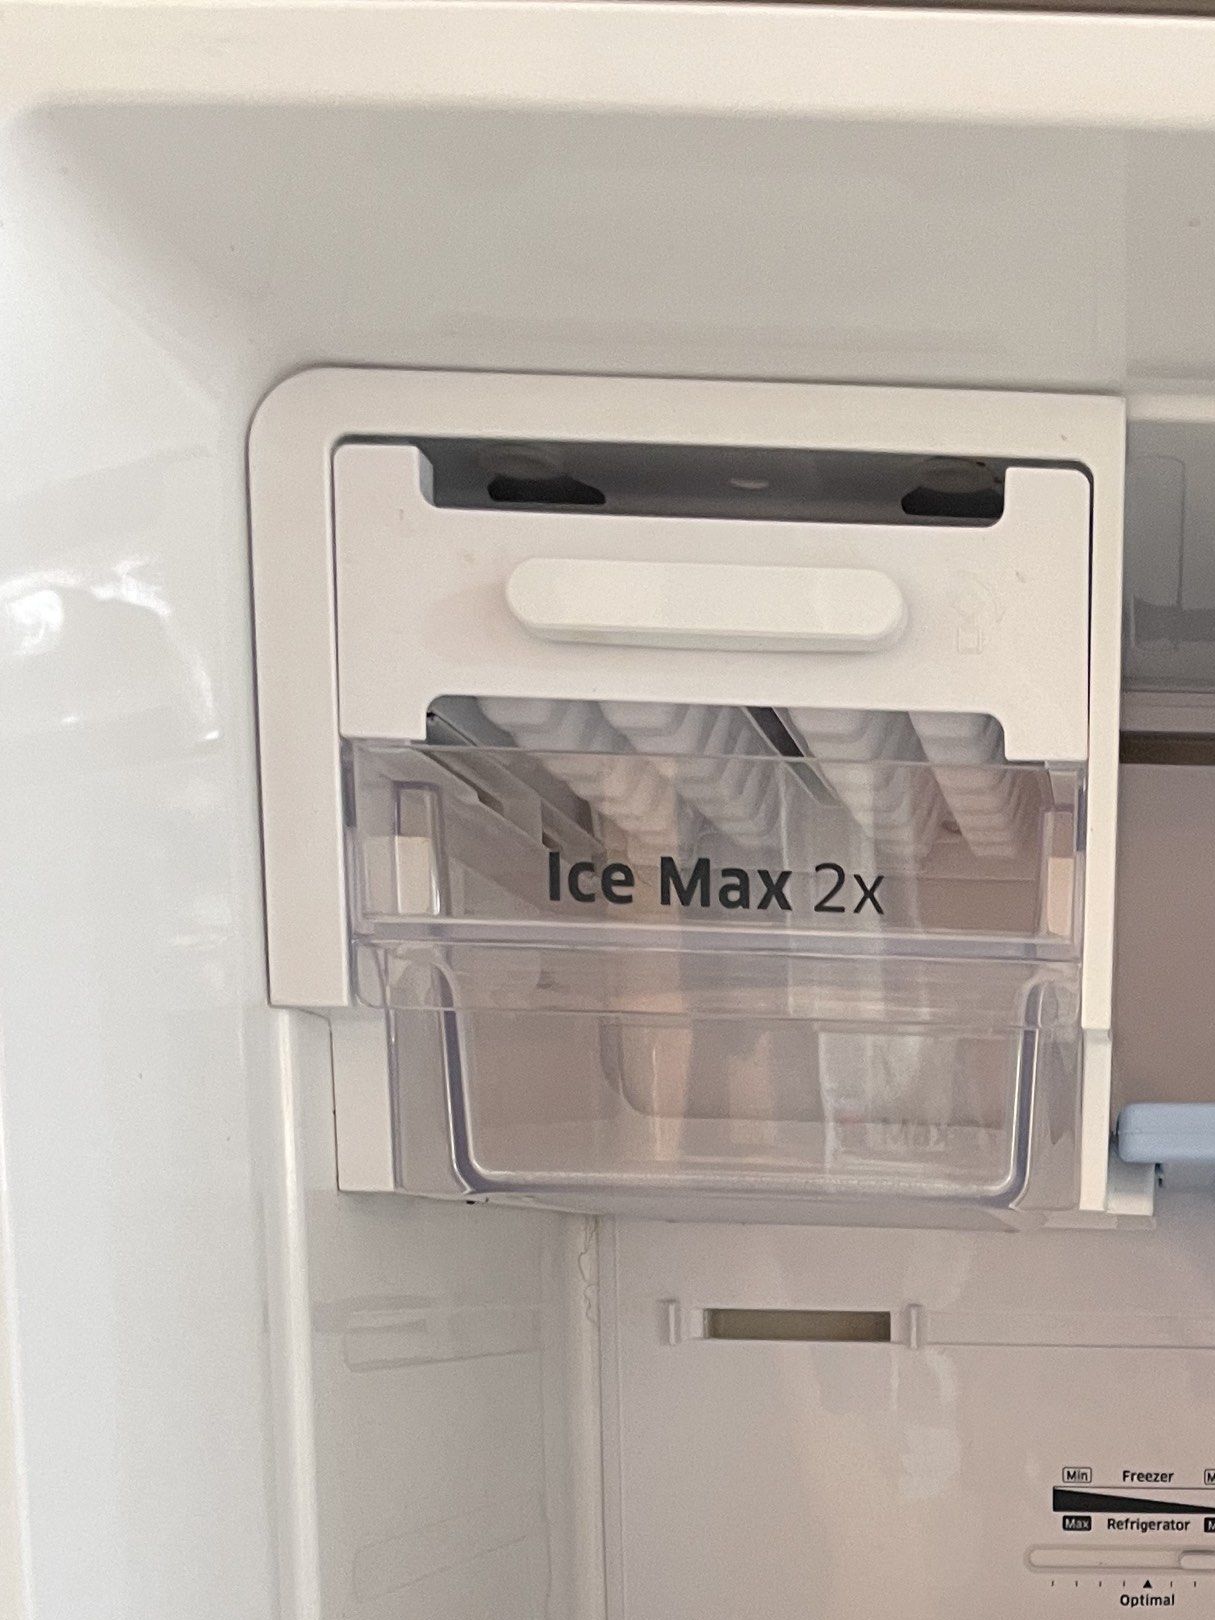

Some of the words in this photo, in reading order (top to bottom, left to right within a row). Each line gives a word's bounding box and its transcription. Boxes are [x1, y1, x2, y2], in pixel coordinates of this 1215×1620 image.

[548, 851, 636, 904] Ice
[659, 855, 794, 911] Max
[813, 862, 886, 914] 2x
[1066, 1470, 1089, 1481] Min
[1122, 1470, 1175, 1483] Freezer
[1065, 1518, 1090, 1529] Max
[1107, 1518, 1191, 1533] Refrigerator
[1119, 1594, 1175, 1608] Optimal
